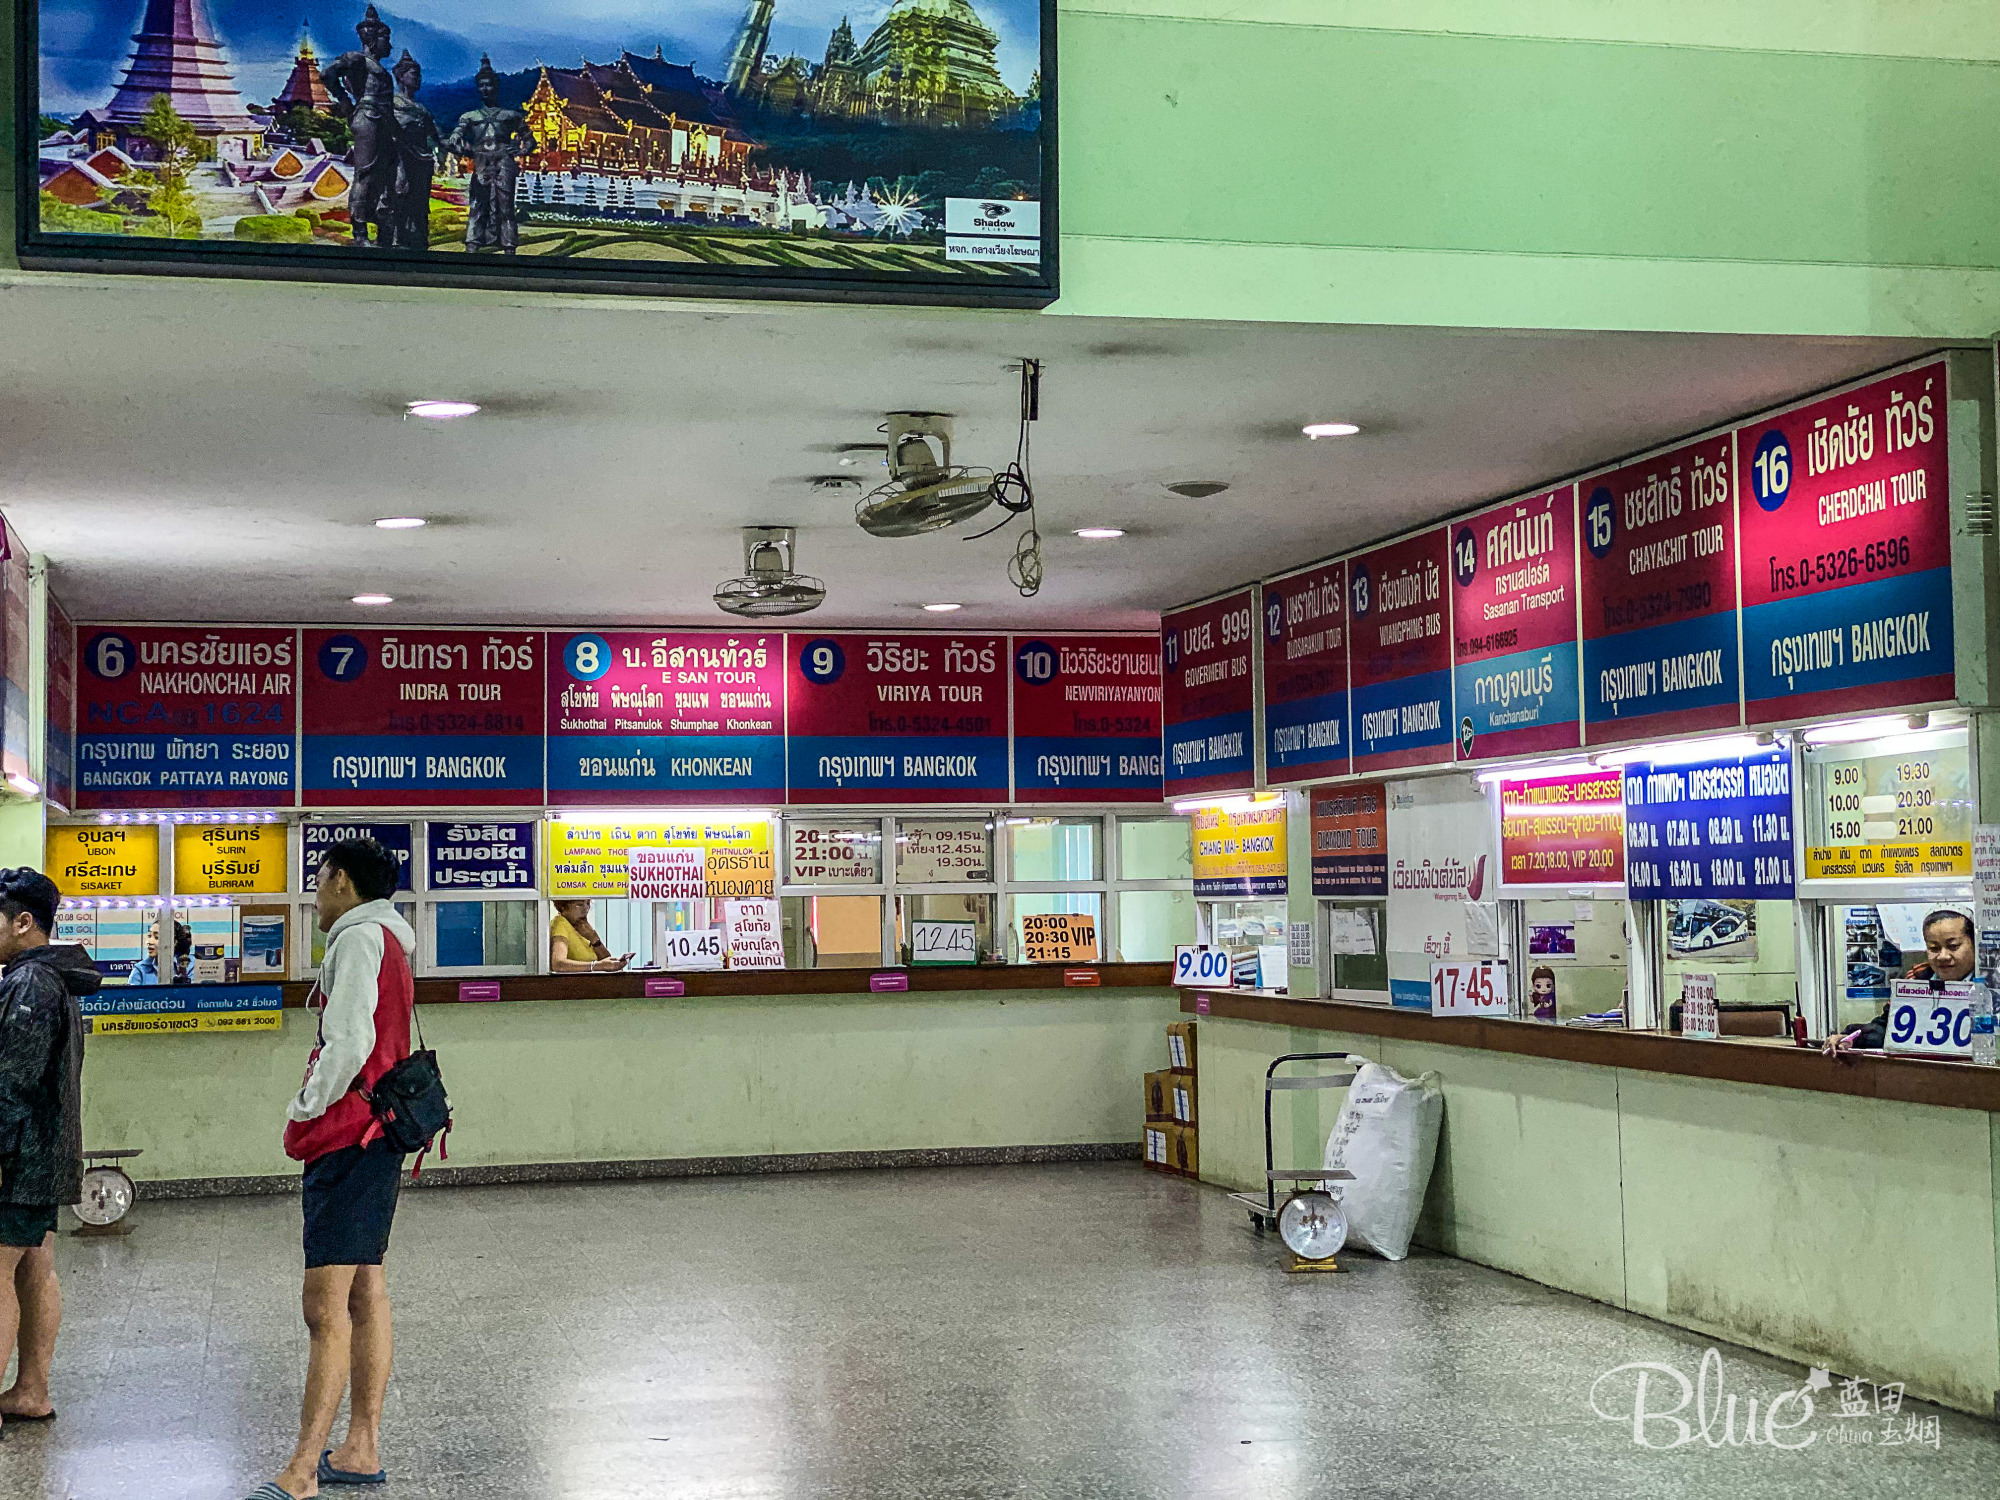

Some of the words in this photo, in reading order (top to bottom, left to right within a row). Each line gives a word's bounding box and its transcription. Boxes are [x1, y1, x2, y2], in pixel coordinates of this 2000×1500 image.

[974, 218, 1015, 227] Shadow
[1808, 405, 1874, 476] เชิดชัย
[1885, 378, 1934, 453] ทัวร์
[1691, 446, 1727, 510] ทัวร์
[1755, 445, 1788, 498] 16
[1818, 479, 1886, 526] CHERDCHAI
[1891, 469, 1926, 506] TOUR
[1588, 503, 1611, 547] 15
[1456, 539, 1474, 575] 14
[1630, 534, 1687, 575] CHAYACHIT
[1692, 524, 1724, 558] TOUR
[1770, 536, 1910, 592] โทร.0-5326-6596
[1353, 577, 1368, 612] 13
[1483, 599, 1519, 621] Sasanan
[1521, 585, 1564, 611] Transport
[1222, 608, 1249, 645] 999
[1267, 605, 1280, 636] 12
[1426, 613, 1440, 637] BUS
[141, 634, 293, 666] นครชัยแอร์
[1166, 634, 1178, 664] 11
[1326, 627, 1341, 649] TOUR
[97, 638, 124, 677] 6
[331, 647, 354, 674] 7
[381, 637, 467, 670] อินทรา
[482, 636, 533, 670] ทัวร์
[576, 642, 599, 673] 8
[813, 648, 833, 674] 9
[866, 642, 929, 672] วิริยะ
[944, 641, 995, 672] ทัวร์
[1772, 627, 1843, 690] กรุงเทพฯ
[1852, 612, 1930, 663] BANGKOK
[662, 672, 671, 683] E
[678, 672, 708, 683] SAN
[714, 672, 755, 683] TOUR
[1020, 652, 1051, 678] 10
[1185, 660, 1228, 688] GOVERMENT
[1232, 655, 1247, 677] BUS
[141, 673, 255, 694] NAKHONCHAI
[263, 673, 290, 694] AIR
[400, 684, 448, 700] INDRA
[458, 684, 501, 700] TOUR
[1475, 652, 1553, 707] กาญจนบุรี
[1601, 661, 1656, 715] กรุงเทพฯ
[1662, 649, 1722, 692] BANGKOK
[561, 684, 599, 715] สุโขทัย
[720, 686, 771, 708] ขอนแก่น
[877, 685, 931, 701] VIRIYA
[939, 686, 983, 701] TOUR
[204, 702, 283, 724] 1624
[561, 719, 606, 730] Sukhothai
[615, 719, 662, 730] Pitsanulok
[670, 719, 718, 731] Shumphae
[727, 719, 772, 729] Khonkean
[1308, 719, 1340, 749] BANGKOK
[1363, 708, 1399, 752] กรุงเทพฯ
[1402, 700, 1441, 734] BANGKOK
[82, 742, 155, 766] กรุงเทพ
[167, 738, 219, 759] พัทยา
[232, 743, 289, 760] ระยอง
[1209, 732, 1243, 761] BANGKOK
[333, 756, 416, 788] กรุงเทพฯ
[426, 756, 506, 778] BANGKOK
[579, 749, 656, 776] ขอนแก่น
[671, 758, 752, 776] KHONKEAN
[819, 756, 894, 786] กรุงเทพฯ
[903, 756, 977, 777] BANGKOK
[1037, 755, 1110, 785] กรุงเทพฯ
[1834, 768, 1858, 785] 9.00
[1897, 762, 1929, 781] 19.30
[83, 772, 150, 786] BANGKOK
[161, 772, 223, 785] PATTAYA
[230, 771, 288, 785] RAYONG
[1627, 776, 1643, 805] ตาก
[1689, 756, 1745, 800] นครสวรรค์
[1749, 755, 1789, 796] หมอชิต
[1829, 795, 1859, 812] 10.00
[1898, 790, 1931, 807] 20.30
[77, 831, 126, 847] อุบลฯ
[202, 826, 260, 846] สุรินทร์
[447, 824, 516, 842] รังสิต
[566, 828, 601, 839] ลำปาง
[637, 830, 656, 839] ตาก
[664, 826, 698, 844] สุโขทัย
[704, 826, 751, 843] พิษณุโลก
[1318, 829, 1351, 850] DIAMOND
[1356, 827, 1378, 848] TOUR
[1629, 822, 1648, 847] 06.30
[1667, 820, 1689, 846] 07.20
[1709, 817, 1732, 845] 08.20
[1753, 813, 1777, 842] 11.30
[1830, 822, 1860, 839] 15.00
[1899, 817, 1932, 835] 21.00
[87, 847, 115, 855] UBON
[437, 844, 525, 861] หมอชิต
[712, 847, 753, 855] PHITNULOK
[795, 847, 854, 860] 21:00
[1200, 841, 1221, 856] CHIANG
[1242, 837, 1274, 852] BANGKOK
[1572, 850, 1586, 868] VIP
[1589, 849, 1613, 868] 20.00
[65, 861, 137, 877] ศรีสะเกษ
[202, 860, 260, 879] บุรีรัมย์
[435, 863, 527, 888] ประตูน้ำ
[630, 866, 703, 881] SUKHOTHAI
[794, 867, 826, 877] VIP
[1631, 861, 1650, 887] 14.00
[1669, 860, 1691, 887] 16.30
[1711, 859, 1734, 886] 18.00
[1755, 857, 1780, 885] 21.00
[81, 882, 122, 890] SISAKET
[209, 880, 254, 888] BURIRAM
[630, 884, 703, 899] NONGKHAI
[706, 879, 773, 897] หนองคาย
[741, 905, 763, 915] ตาก
[735, 919, 770, 936] สุโขทัย
[1023, 917, 1068, 929] 20:00
[668, 936, 719, 956] 10.45
[916, 927, 974, 951] 12.45
[1025, 931, 1068, 943] 20:30
[1071, 927, 1095, 946] VIP
[1027, 947, 1071, 958] 21:15
[1179, 952, 1227, 977] 9.00
[1435, 967, 1493, 1007] 17:45
[237, 999, 248, 1007] 24
[1891, 1005, 1971, 1046] 9.30
